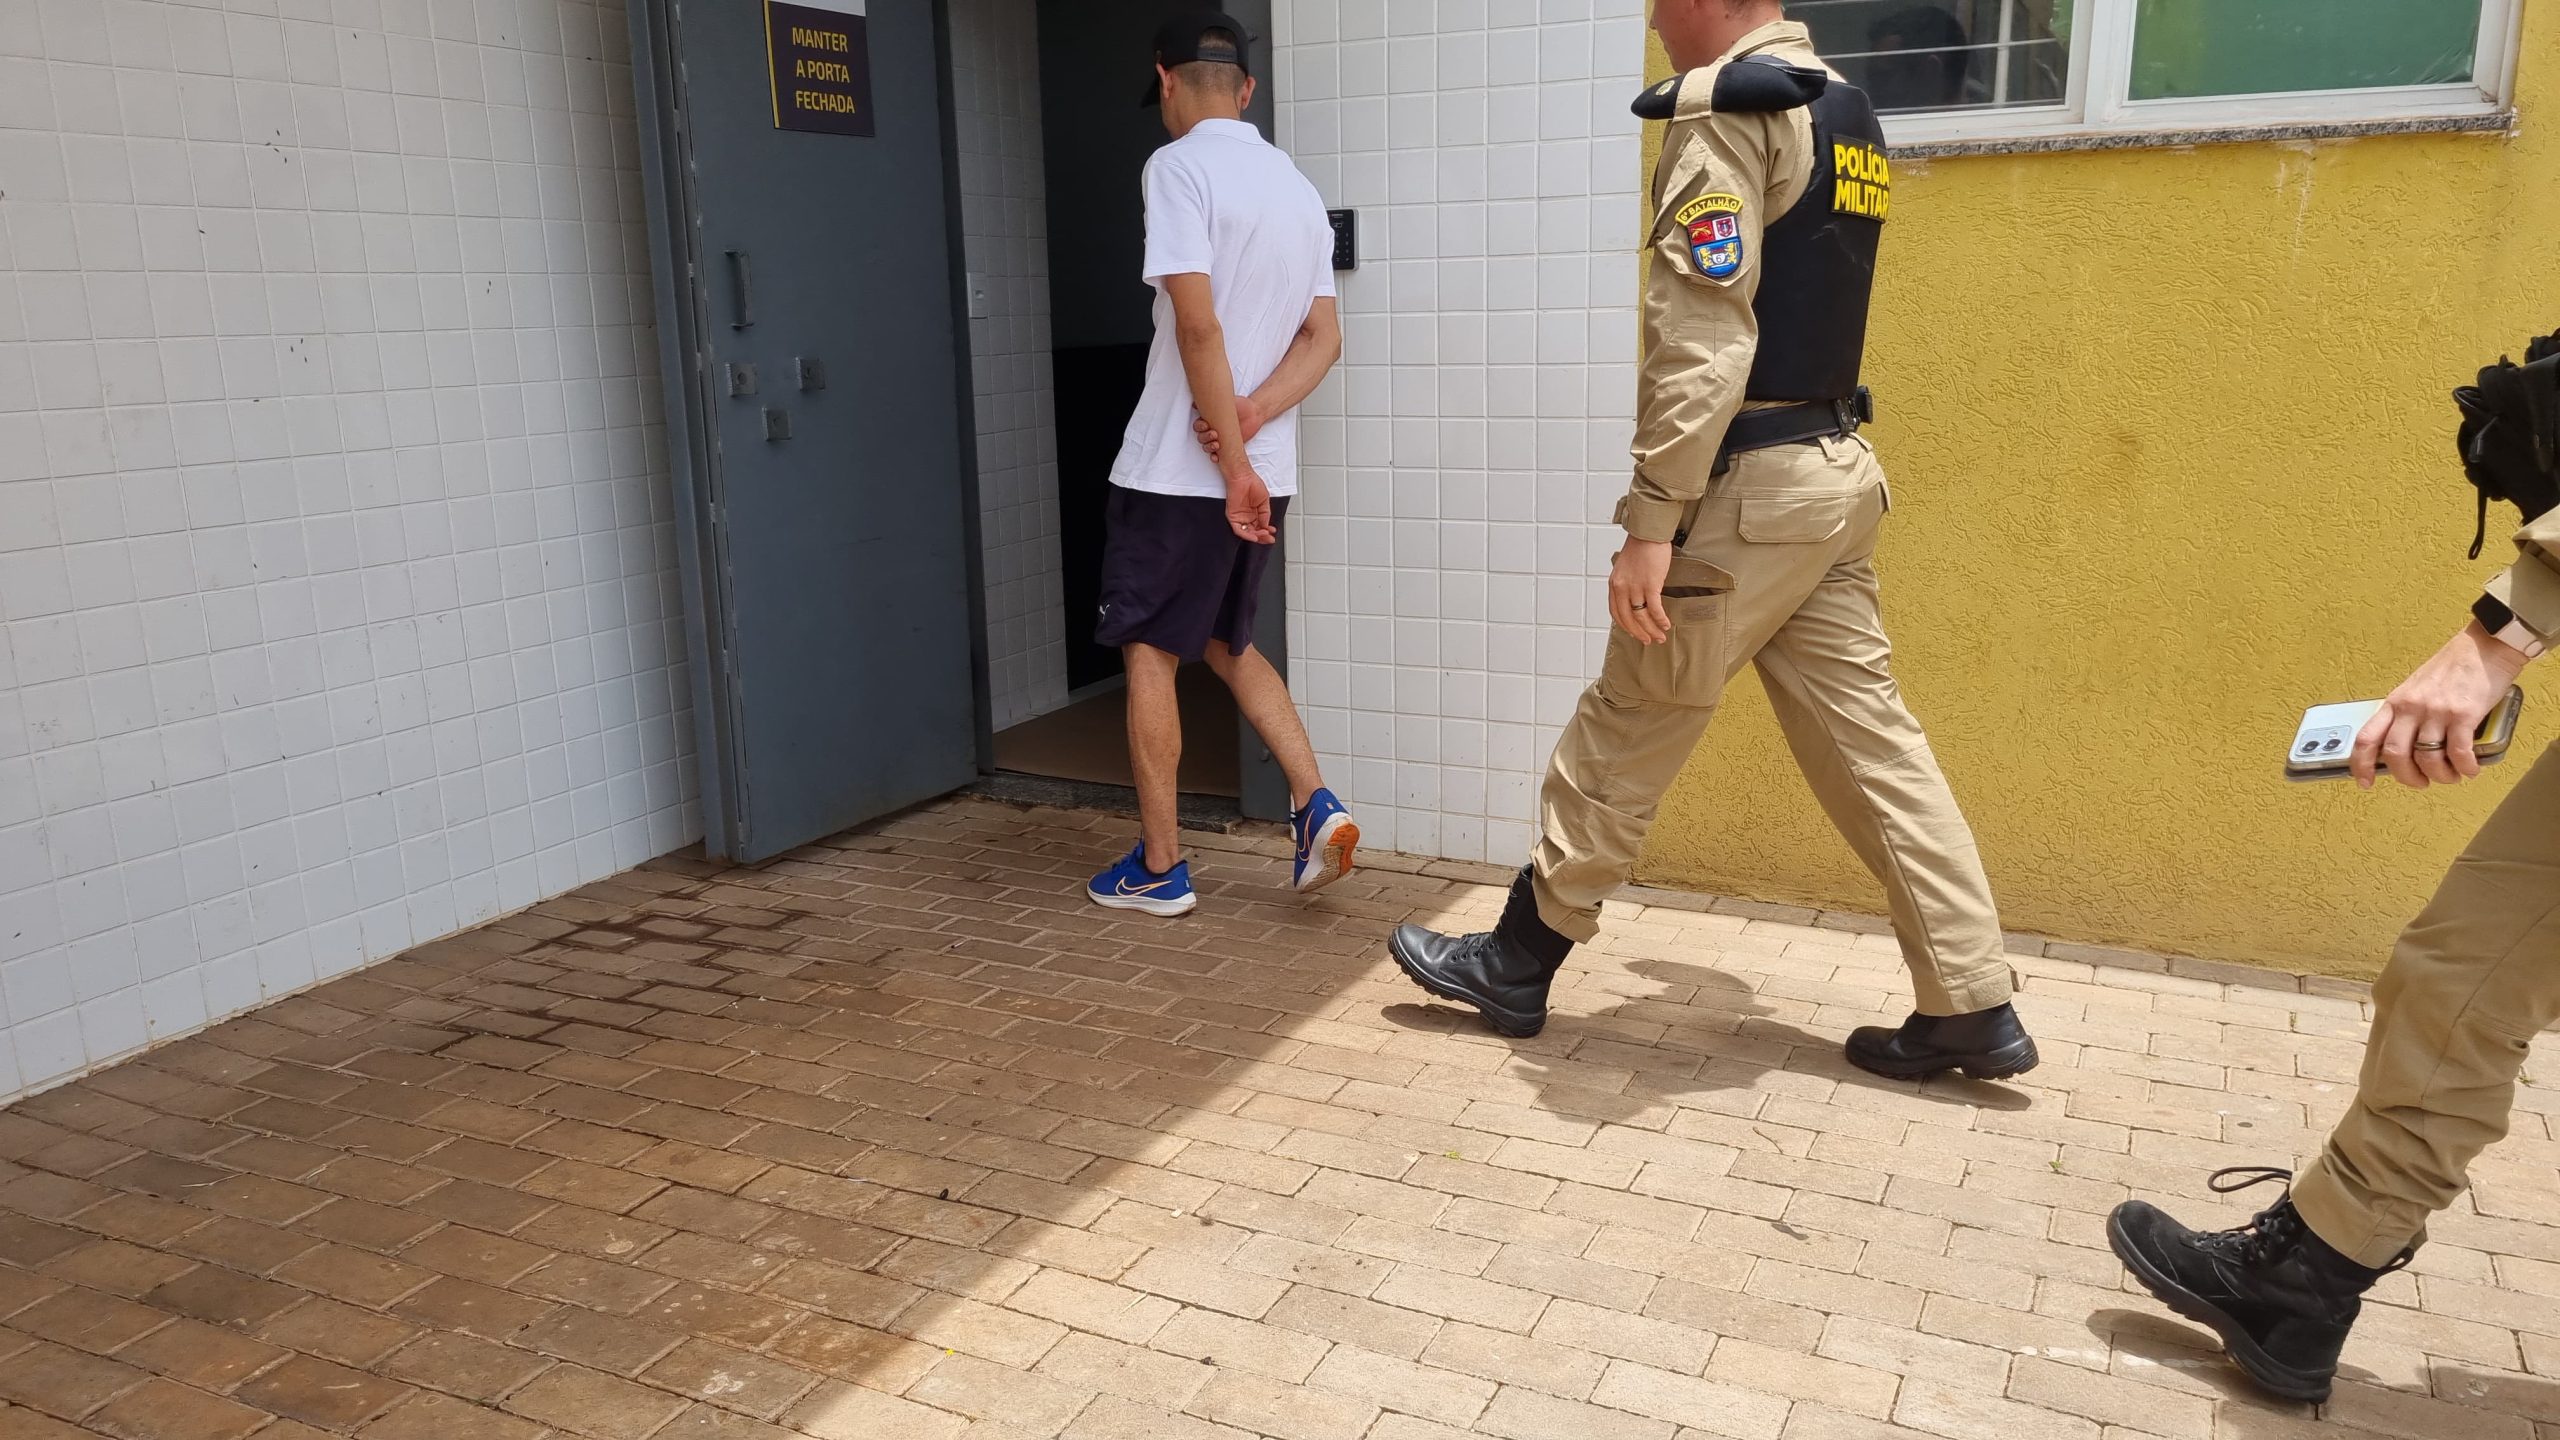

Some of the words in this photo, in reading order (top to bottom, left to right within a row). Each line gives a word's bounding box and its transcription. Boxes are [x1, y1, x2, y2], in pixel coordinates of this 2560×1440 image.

[792, 27, 848, 53] MANTER
[796, 59, 806, 78] A
[807, 60, 850, 83] PORTA
[795, 90, 855, 114] FECHADA
[1834, 144, 1890, 188] POLÍCIA
[1688, 197, 1738, 216] BATALHÃO
[1834, 179, 1889, 220] MILITAR
